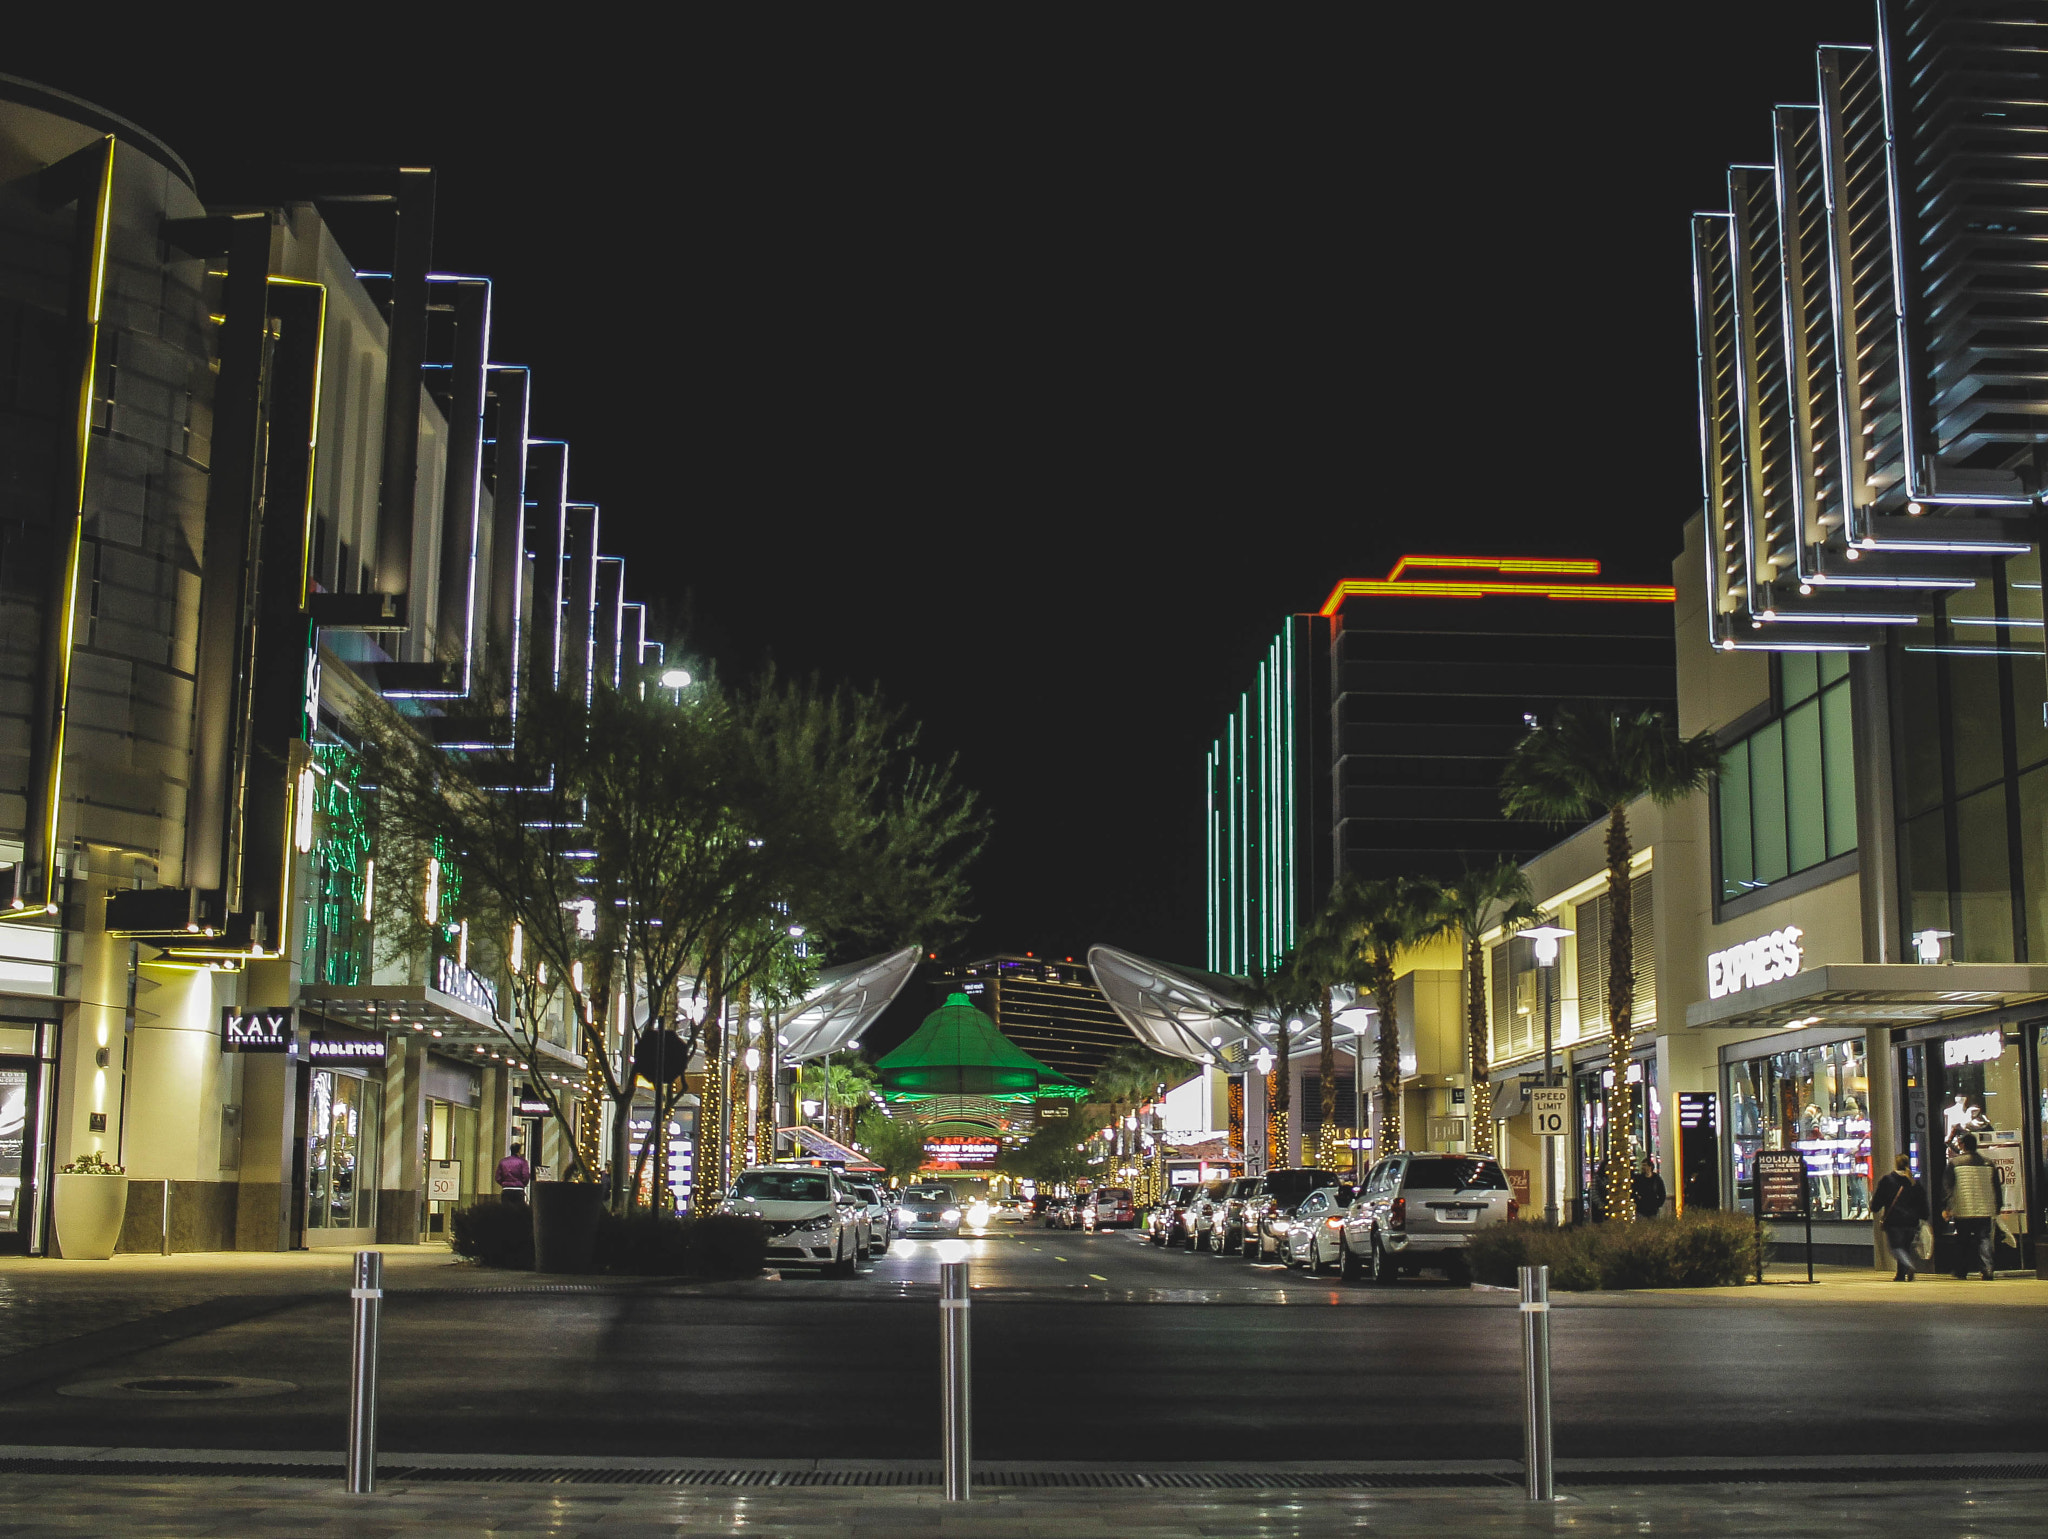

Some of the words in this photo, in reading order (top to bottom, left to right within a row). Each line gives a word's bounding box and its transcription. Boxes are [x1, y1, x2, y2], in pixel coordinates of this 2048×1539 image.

[1708, 926, 1803, 999] EXPRESS
[227, 1016, 284, 1036] KAY
[310, 1043, 384, 1055] FABLETICS
[1534, 1093, 1566, 1101] SPEED
[1537, 1102, 1562, 1110] LIMIT
[1539, 1113, 1562, 1131] 10
[1759, 1155, 1800, 1163] HOLIDAY
